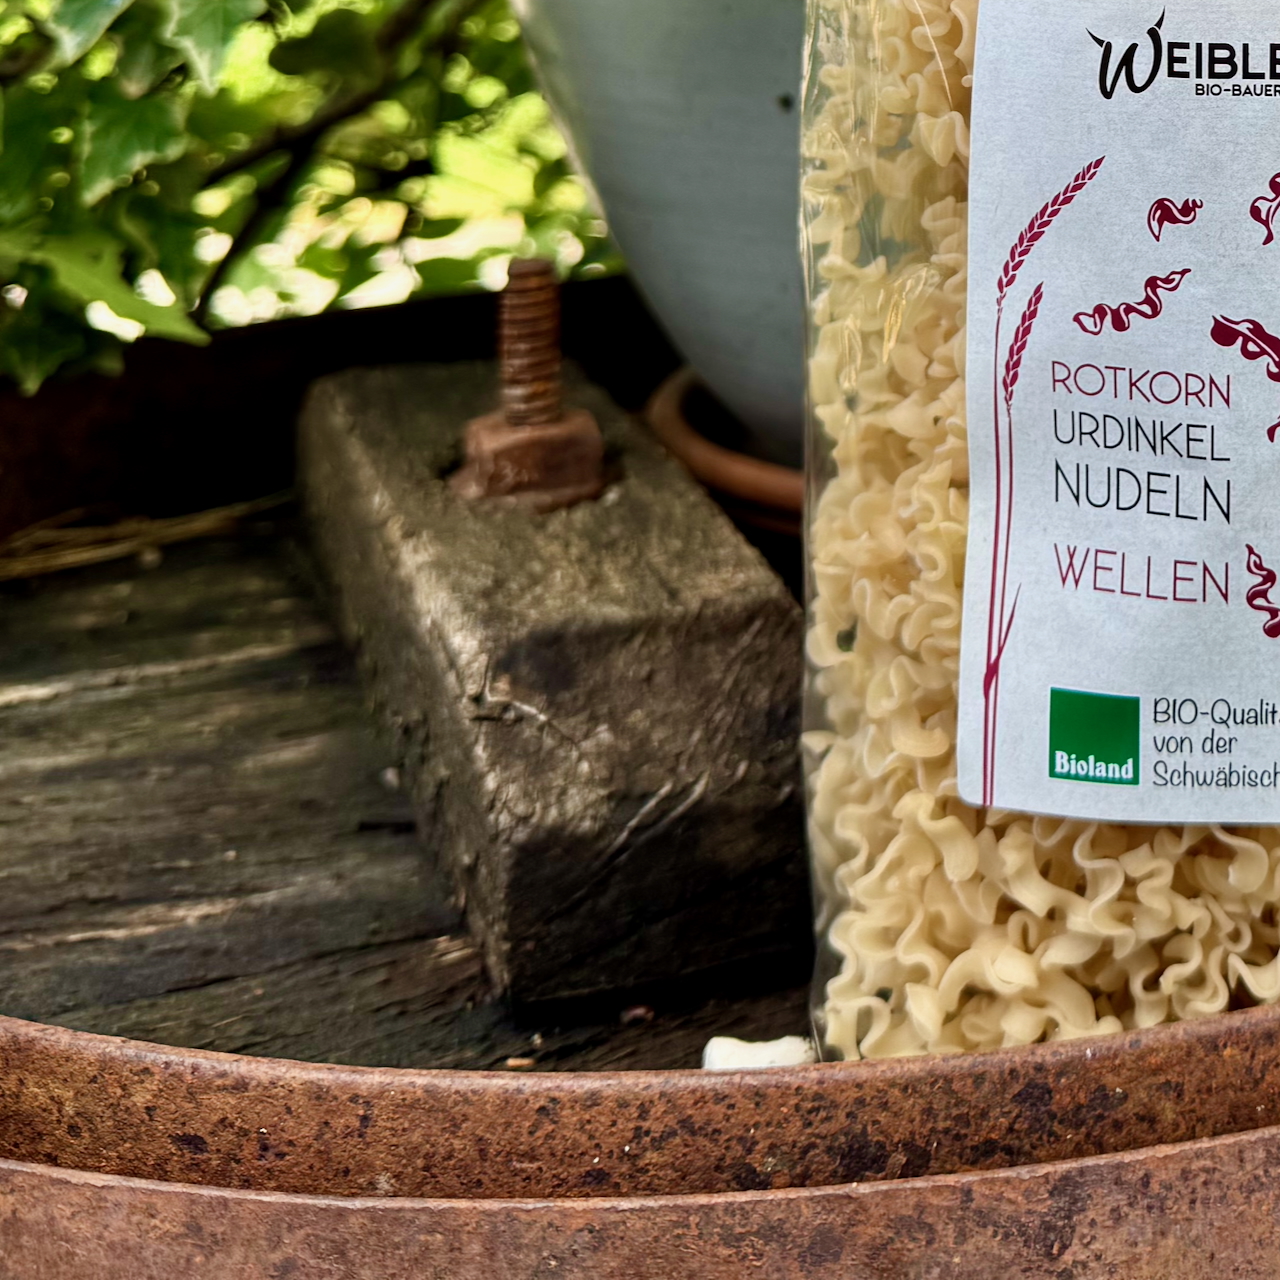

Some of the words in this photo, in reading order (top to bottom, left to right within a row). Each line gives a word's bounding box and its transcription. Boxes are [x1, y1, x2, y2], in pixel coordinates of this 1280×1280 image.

[1051, 360, 1231, 409] ROTKORN
[1053, 408, 1231, 462] URDINKEL
[1054, 457, 1231, 525] NUDELN
[1053, 542, 1230, 606] WELLEN
[1053, 750, 1134, 780] Bioland
[1152, 735, 1194, 754] von
[1201, 728, 1239, 754] der
